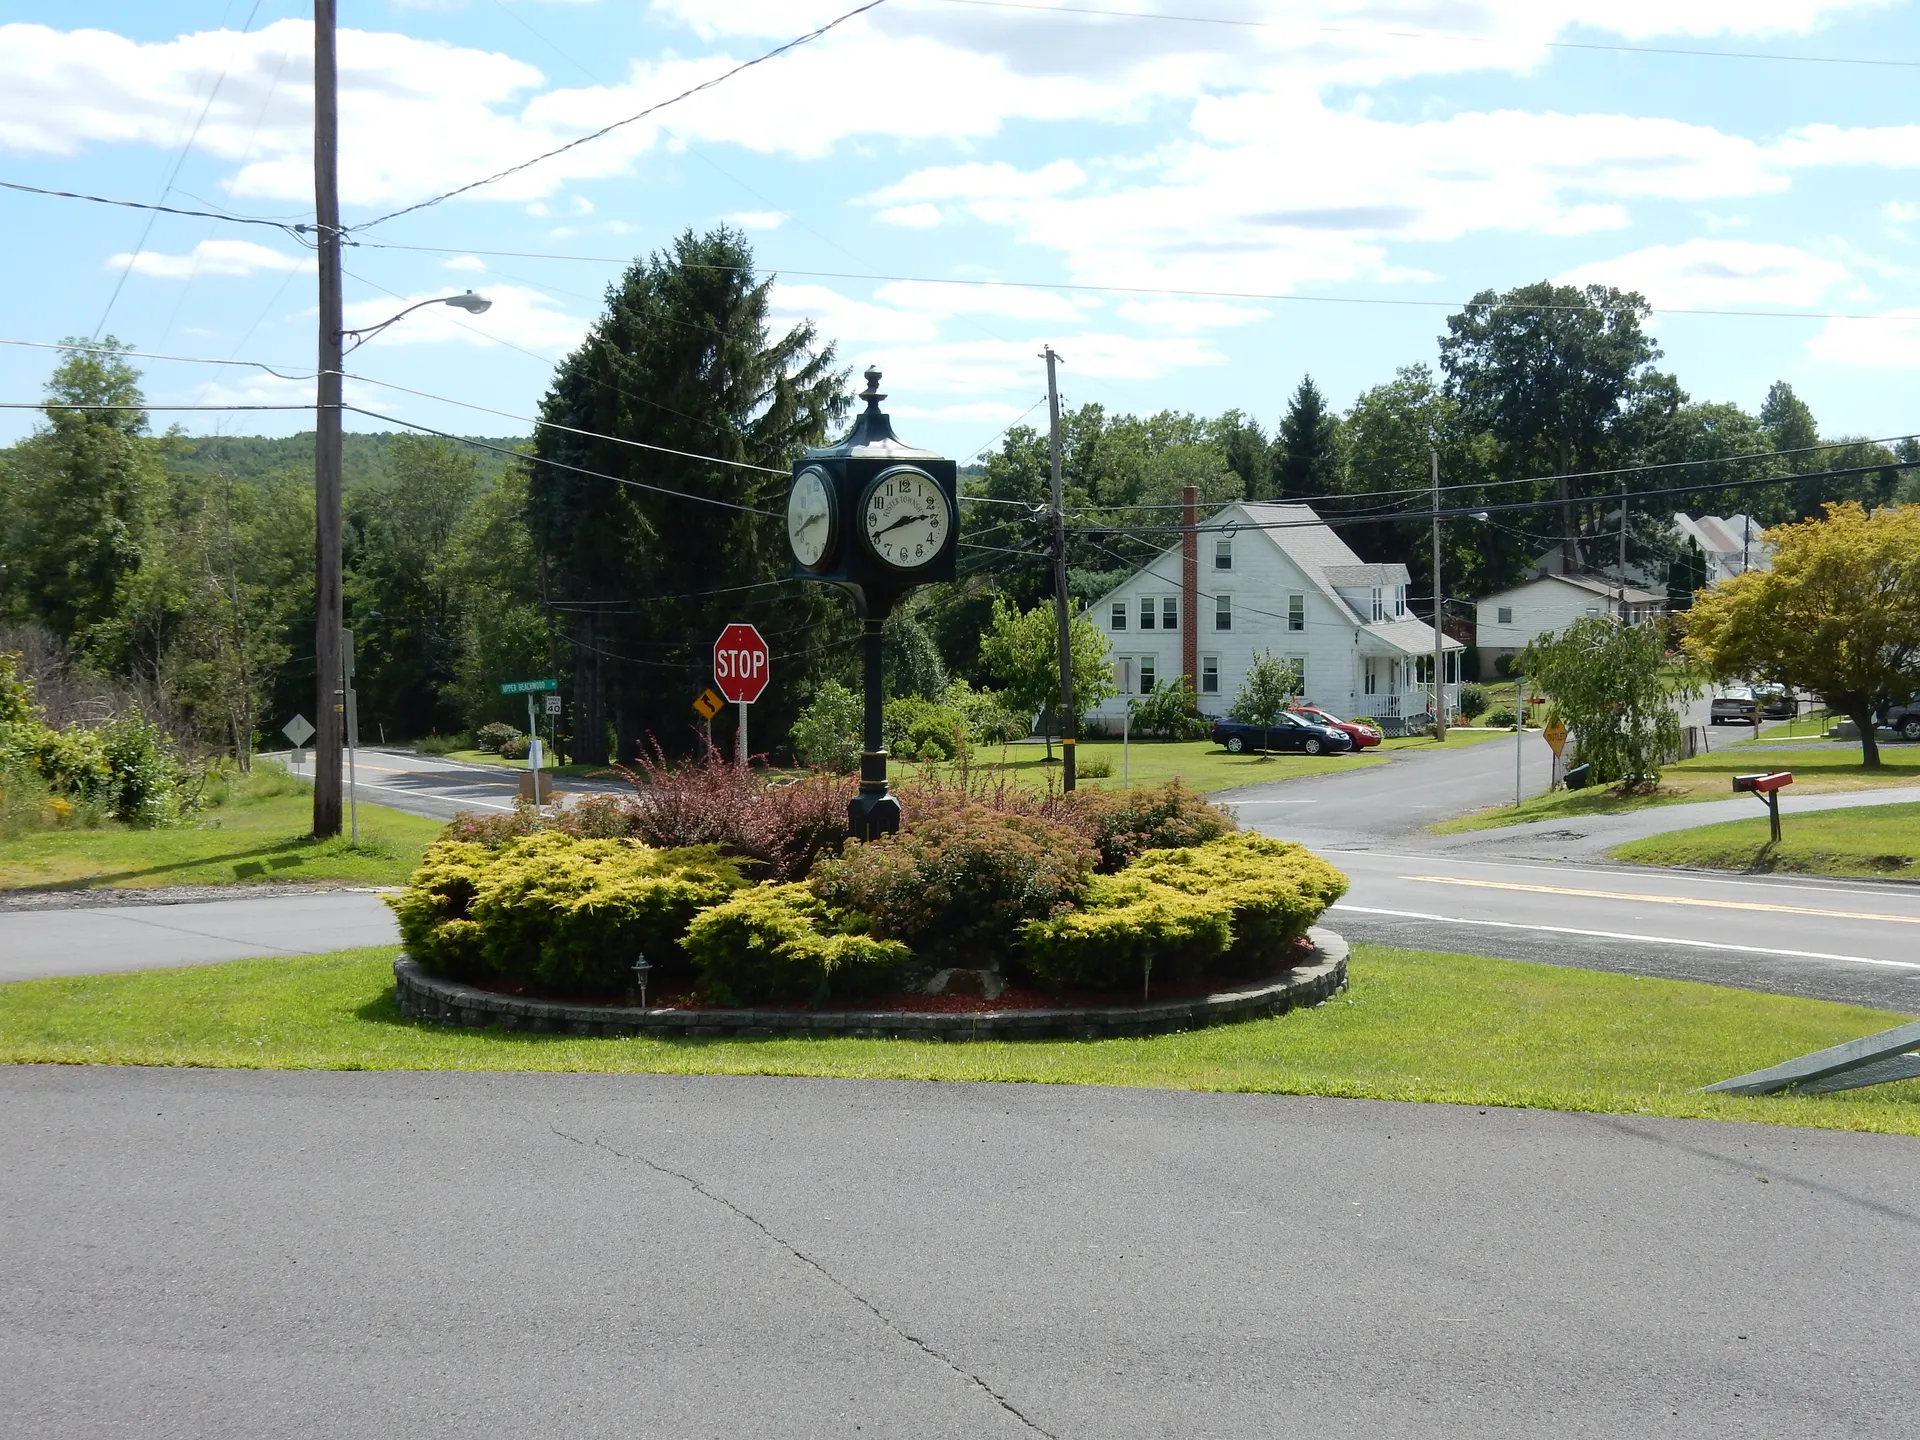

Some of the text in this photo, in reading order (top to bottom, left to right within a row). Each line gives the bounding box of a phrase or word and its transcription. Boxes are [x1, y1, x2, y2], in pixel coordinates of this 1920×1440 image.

[886, 484, 894, 496] 11
[899, 479, 911, 493] 12
[918, 485, 922, 497] 1
[874, 497, 884, 509] 10
[883, 496, 924, 517] FOSTER TOWNSH
[926, 496, 936, 510] 2
[868, 513, 877, 527] 9
[930, 514, 939, 528] 3
[926, 532, 935, 544] 4
[884, 543, 893, 556] 7
[899, 547, 908, 561] 6
[915, 543, 924, 557] 5
[717, 649, 765, 679] STOP
[502, 684, 517, 693] UPPER
[519, 681, 545, 691] BEACHWOOD
